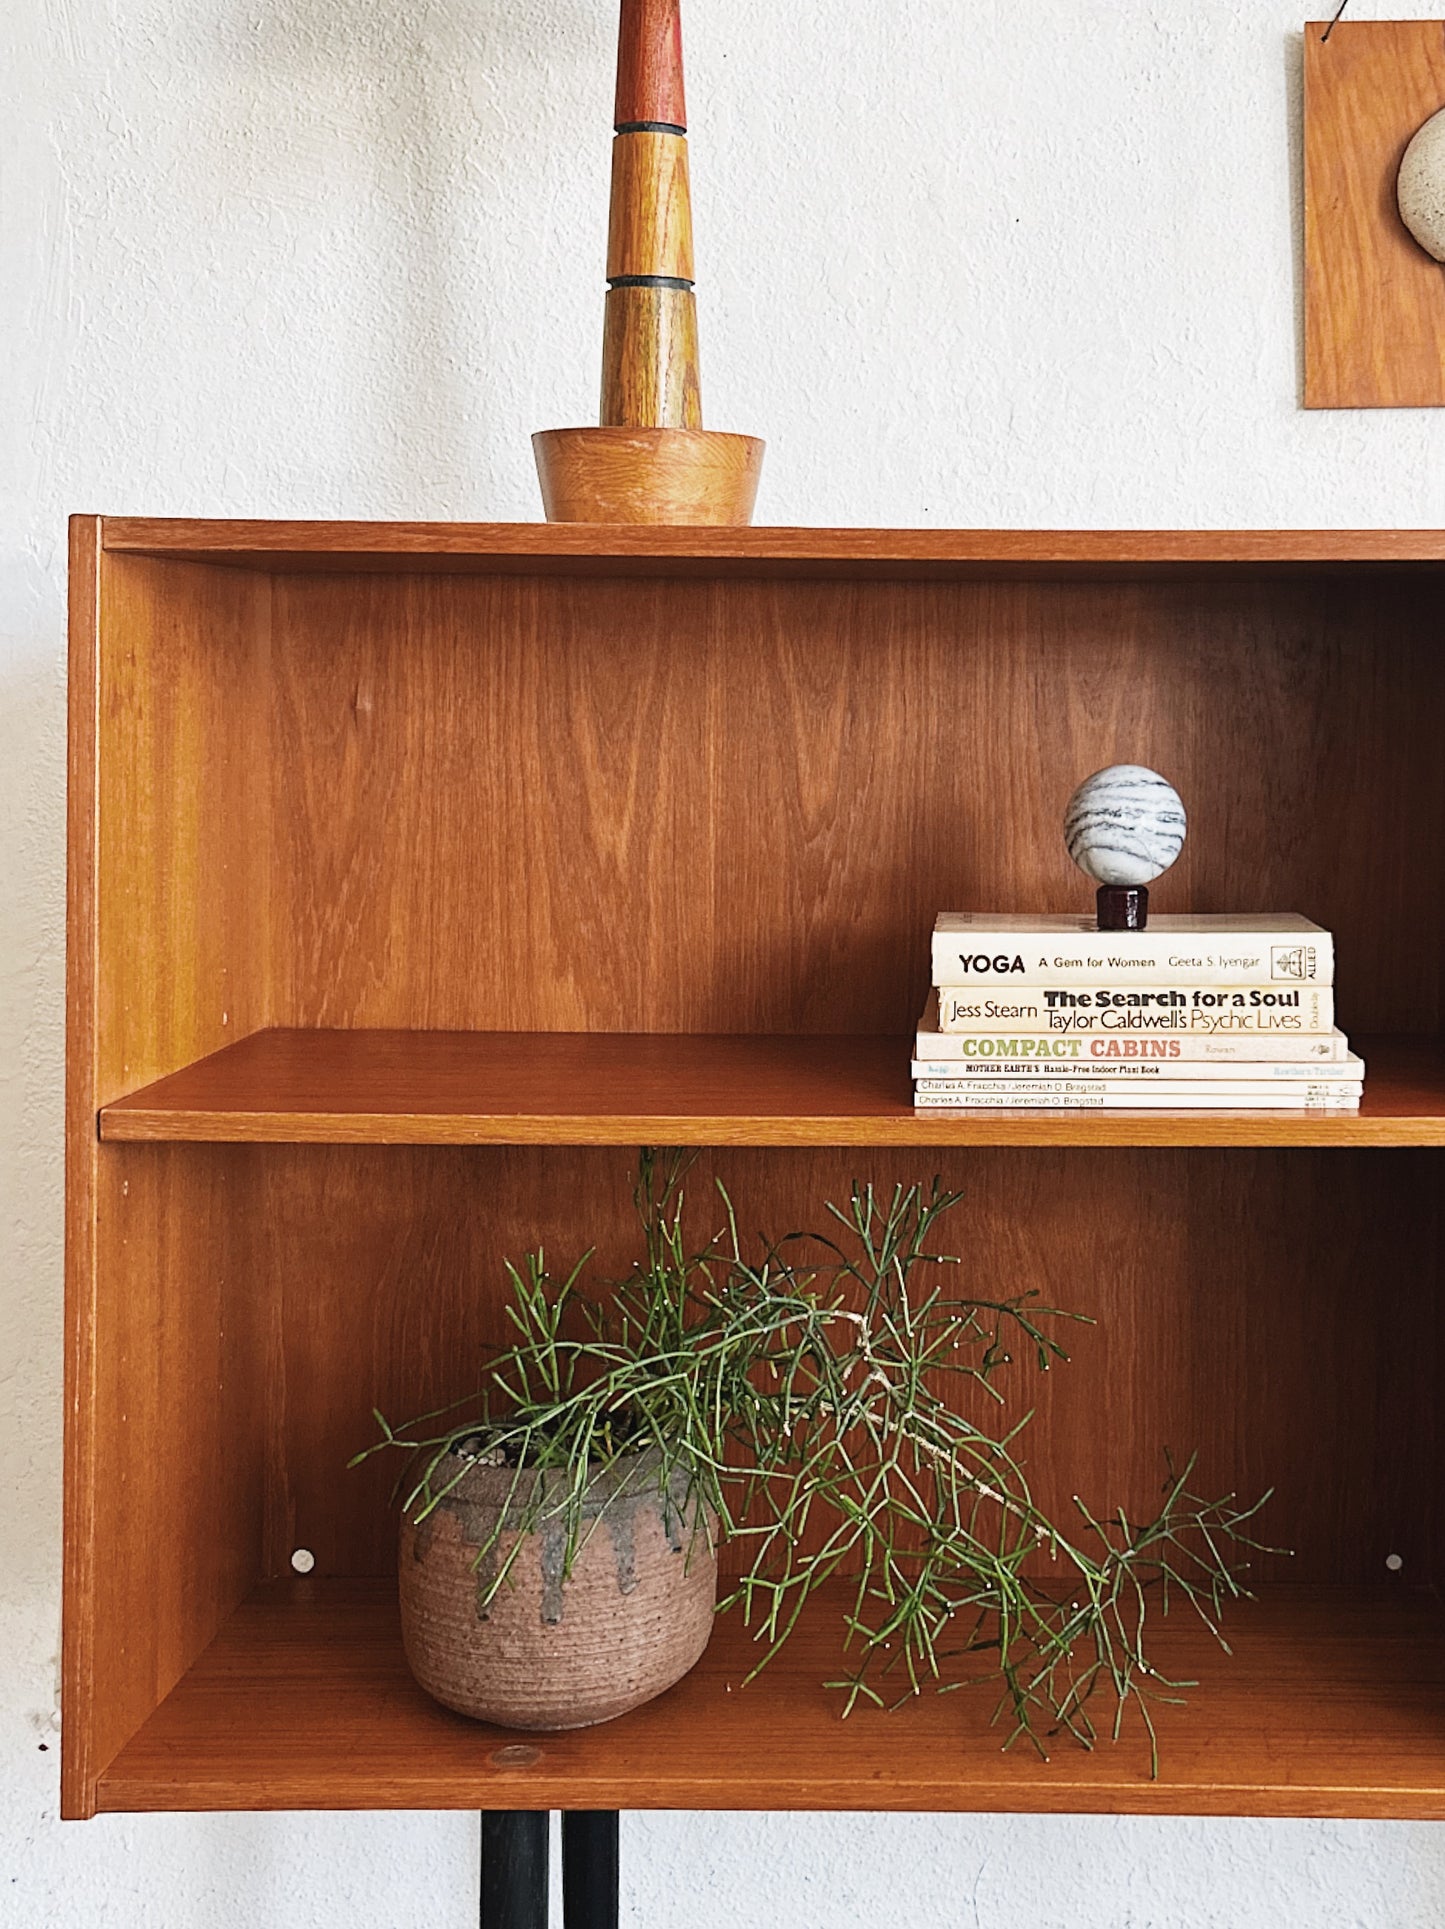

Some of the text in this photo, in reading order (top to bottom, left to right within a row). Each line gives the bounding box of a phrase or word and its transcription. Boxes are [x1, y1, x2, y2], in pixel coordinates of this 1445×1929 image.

[959, 954, 1025, 974] YOGA
[1038, 956, 1156, 968] A Gem for Women
[1168, 956, 1203, 967] Geeta
[1219, 955, 1260, 970] Iyengar
[1307, 946, 1316, 980] ALLIED
[1043, 990, 1300, 1008] The Search for a Soul
[950, 1000, 1038, 1022] Jess Stearn
[1043, 1009, 1302, 1035] Taylor Caldwell's Psychic Lives
[962, 1039, 1181, 1058] COMPACT CABINS
[965, 1064, 1002, 1073] MOTHER
[1091, 1065, 1117, 1073] Indoor
[1141, 1065, 1160, 1074] Book
[921, 1080, 955, 1090] Charles
[919, 1095, 953, 1105] Charles
